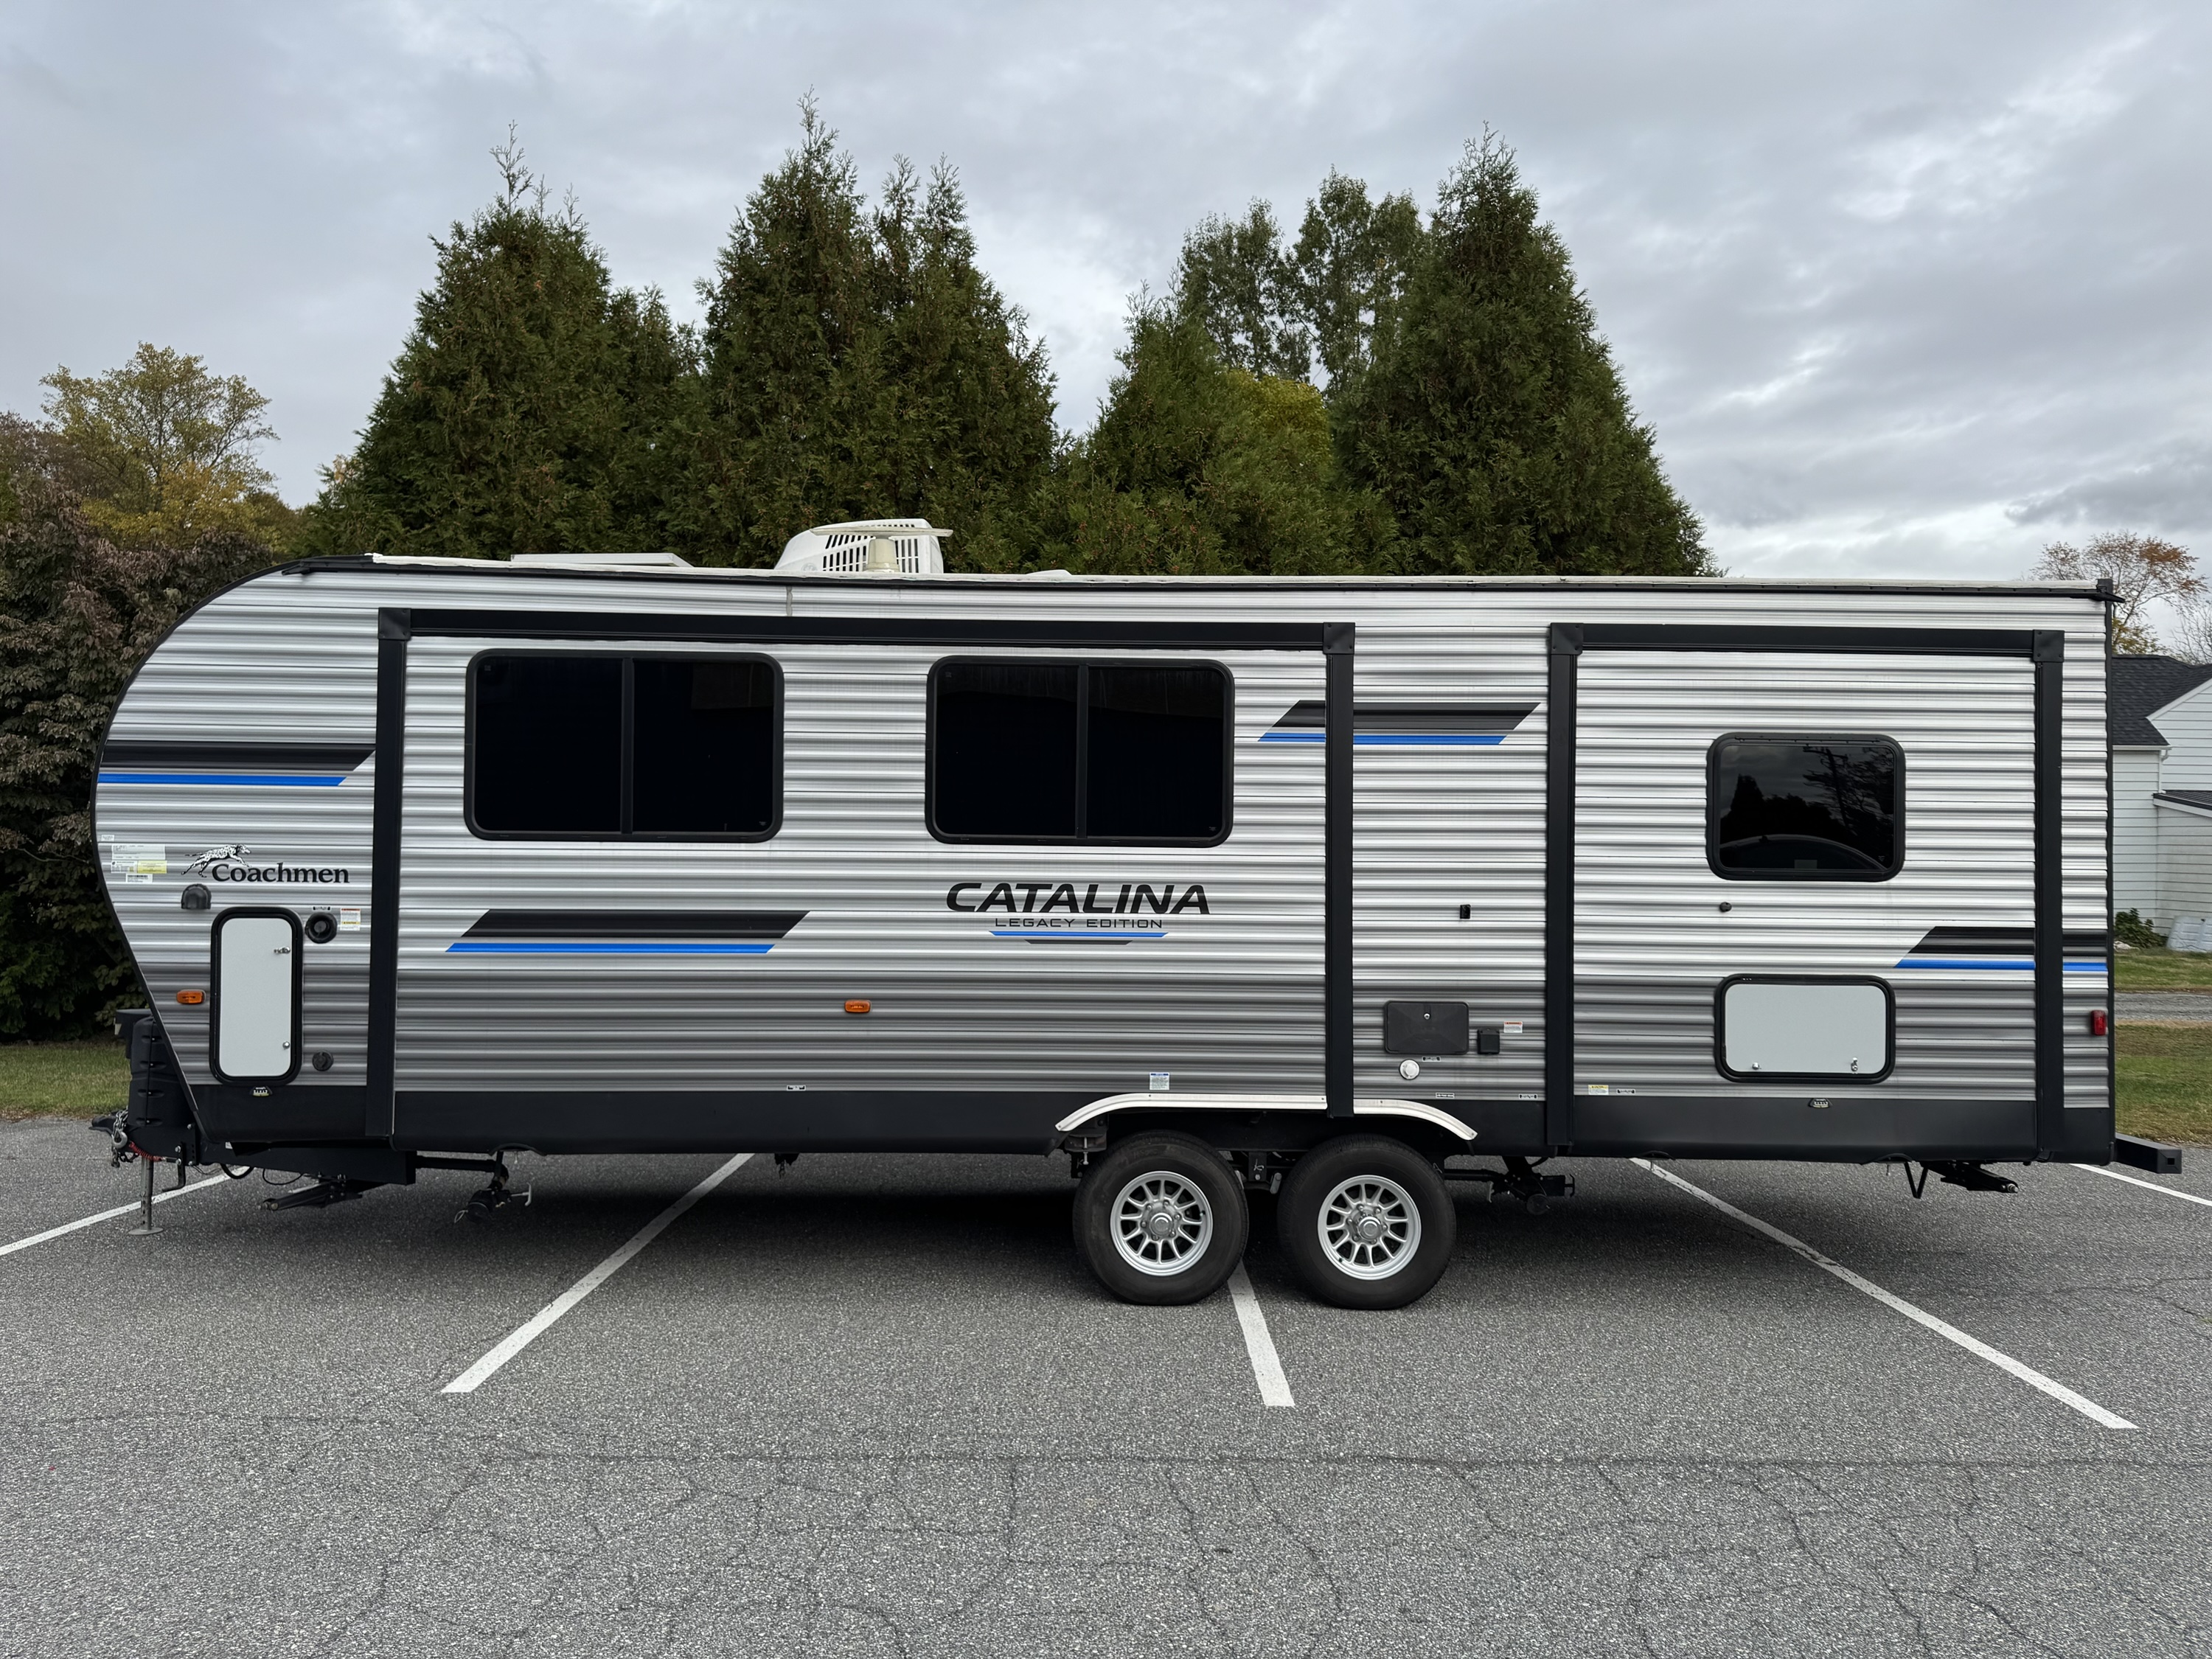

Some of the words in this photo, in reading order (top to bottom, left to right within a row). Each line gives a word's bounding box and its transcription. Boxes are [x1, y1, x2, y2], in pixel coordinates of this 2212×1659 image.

[212, 862, 349, 883] Coachmen
[946, 883, 1210, 915] CATALINA
[995, 918, 1076, 928] LEGACY
[1086, 919, 1163, 928] EDITION
